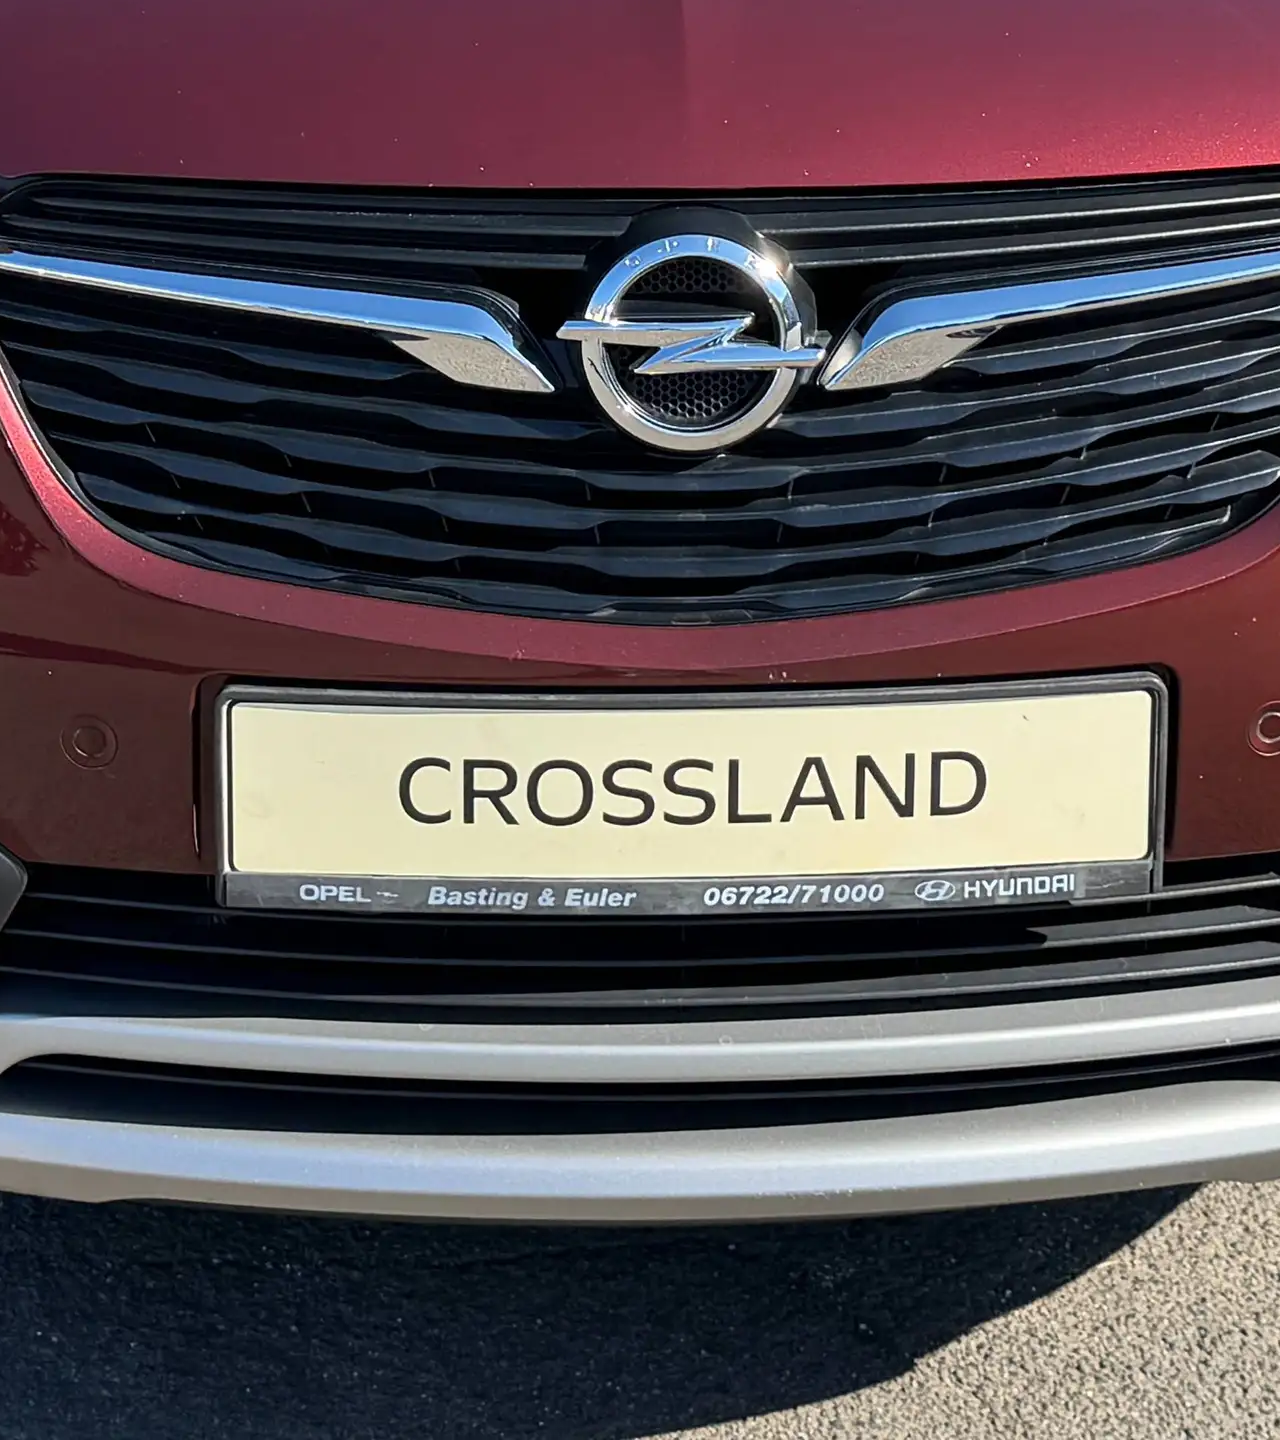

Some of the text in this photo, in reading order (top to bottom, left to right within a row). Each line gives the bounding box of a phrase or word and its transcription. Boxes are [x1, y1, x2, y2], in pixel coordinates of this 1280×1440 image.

[398, 751, 987, 826] CROSSLAND
[299, 873, 1076, 910] OPEL Basting & Euler 06722/71000 HYUNDAI
